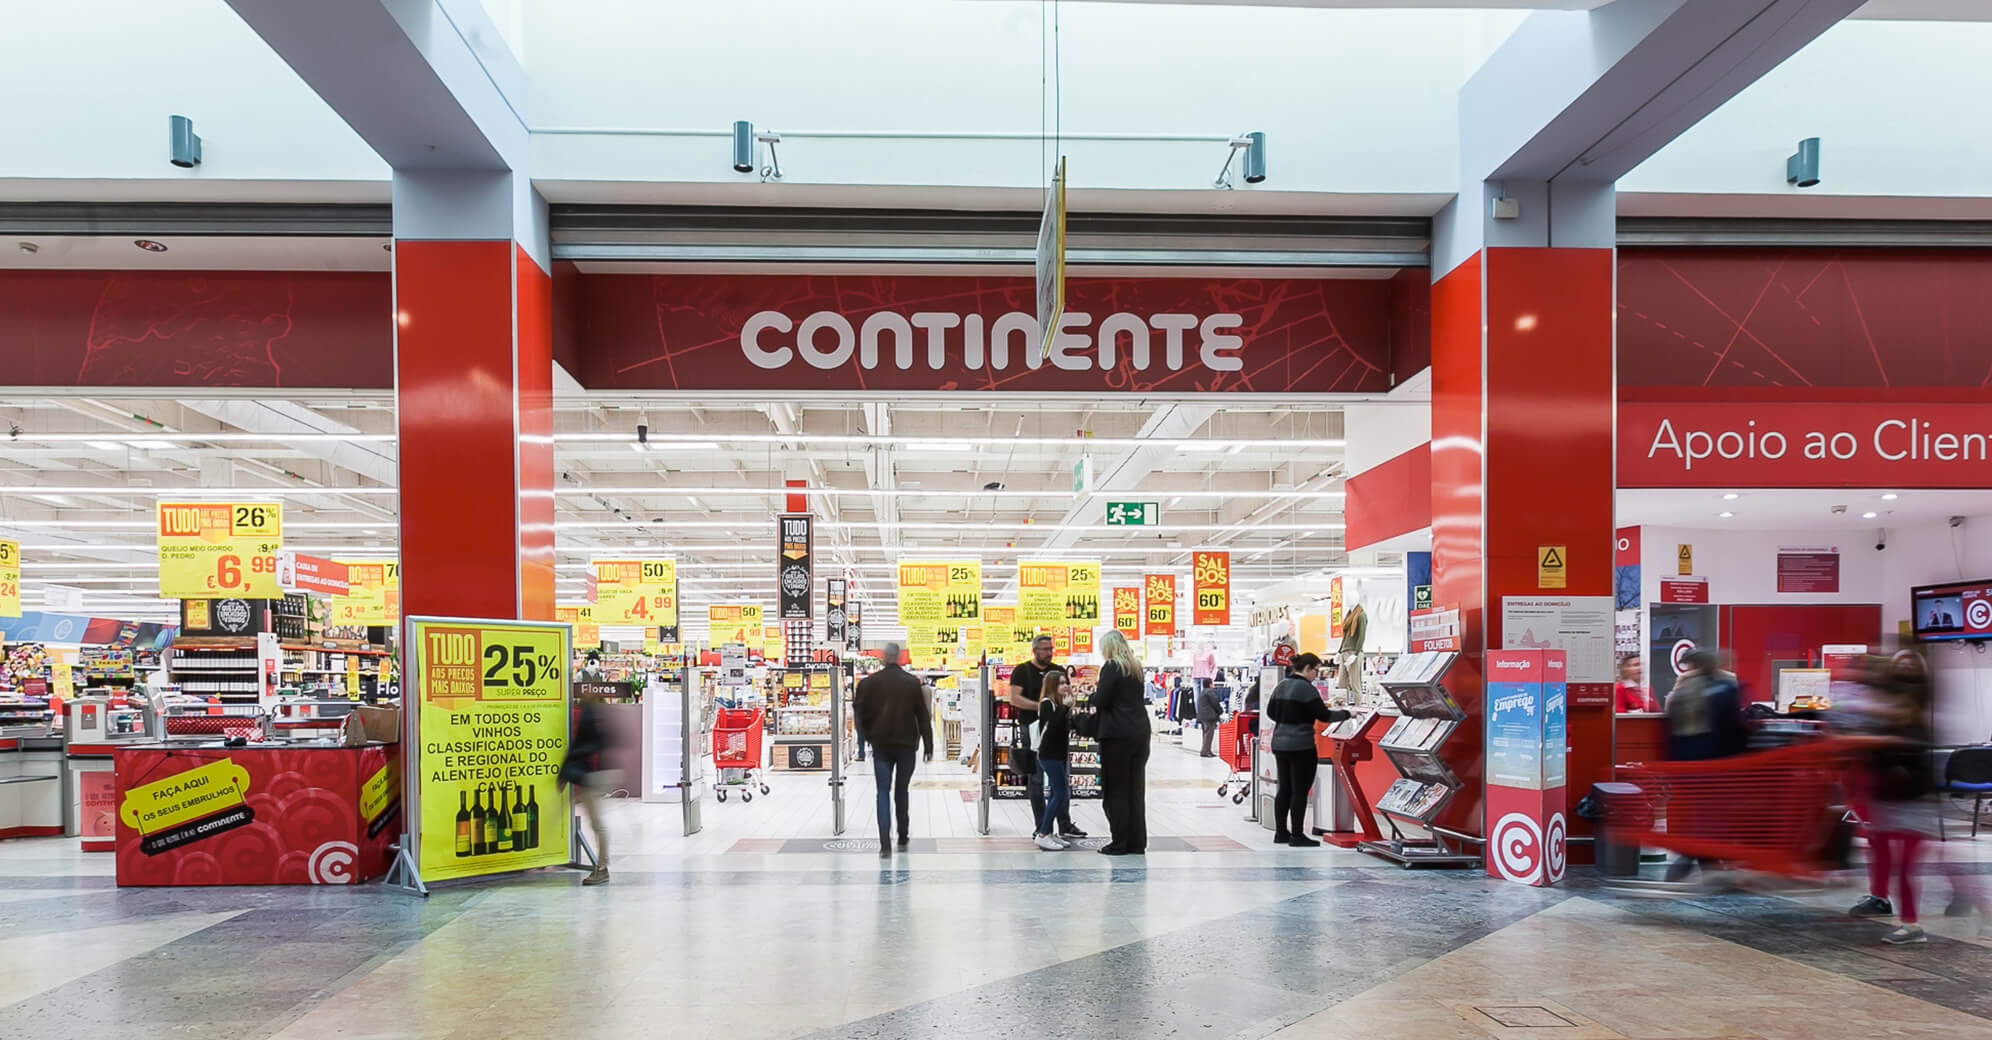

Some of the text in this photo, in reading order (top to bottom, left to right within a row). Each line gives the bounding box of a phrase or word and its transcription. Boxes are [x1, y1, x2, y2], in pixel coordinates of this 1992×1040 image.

[740, 311, 1243, 371] CONTINENTE
[1648, 418, 1992, 470] Apoio ao Clien
[163, 508, 200, 533] TUDO
[784, 520, 807, 536] TUDO
[1199, 554, 1226, 571] SAL
[349, 565, 361, 584] DO
[598, 564, 620, 581] UDO
[902, 568, 926, 585] TUDO
[1022, 568, 1046, 585] TUDO
[1195, 568, 1227, 584] DOS
[1150, 576, 1169, 589] SAL
[1117, 589, 1136, 601] SAL
[1147, 587, 1173, 602] DOS
[1199, 593, 1224, 607] 60%
[624, 596, 672, 621] €4,99
[1114, 599, 1137, 611] DOS
[429, 633, 475, 665] TUDO
[1424, 639, 1453, 651] FOLHETOS
[483, 644, 560, 687] 25%
[1496, 660, 1531, 671] Informação
[432, 668, 475, 681] AOS PREÇOS
[377, 684, 399, 696] Flo
[431, 680, 475, 694] MAIS BAIXOS
[496, 689, 547, 698] SUPER PREÇO
[581, 684, 617, 694] Flores
[1494, 695, 1534, 713] Emprego
[451, 713, 541, 726] EM TODOS OS
[473, 727, 521, 739] VINHOS
[427, 738, 563, 755] CLASSIFICADOS DOC
[445, 752, 548, 768] E REGIONAL DO
[431, 764, 560, 783] ALENTEJO (EXCETO
[152, 776, 210, 801] FAÇA AQUI
[478, 780, 518, 793] CAVE)
[143, 785, 236, 822] OS SEUS EMBRULHOS
[196, 811, 246, 833] CONTINENTE
